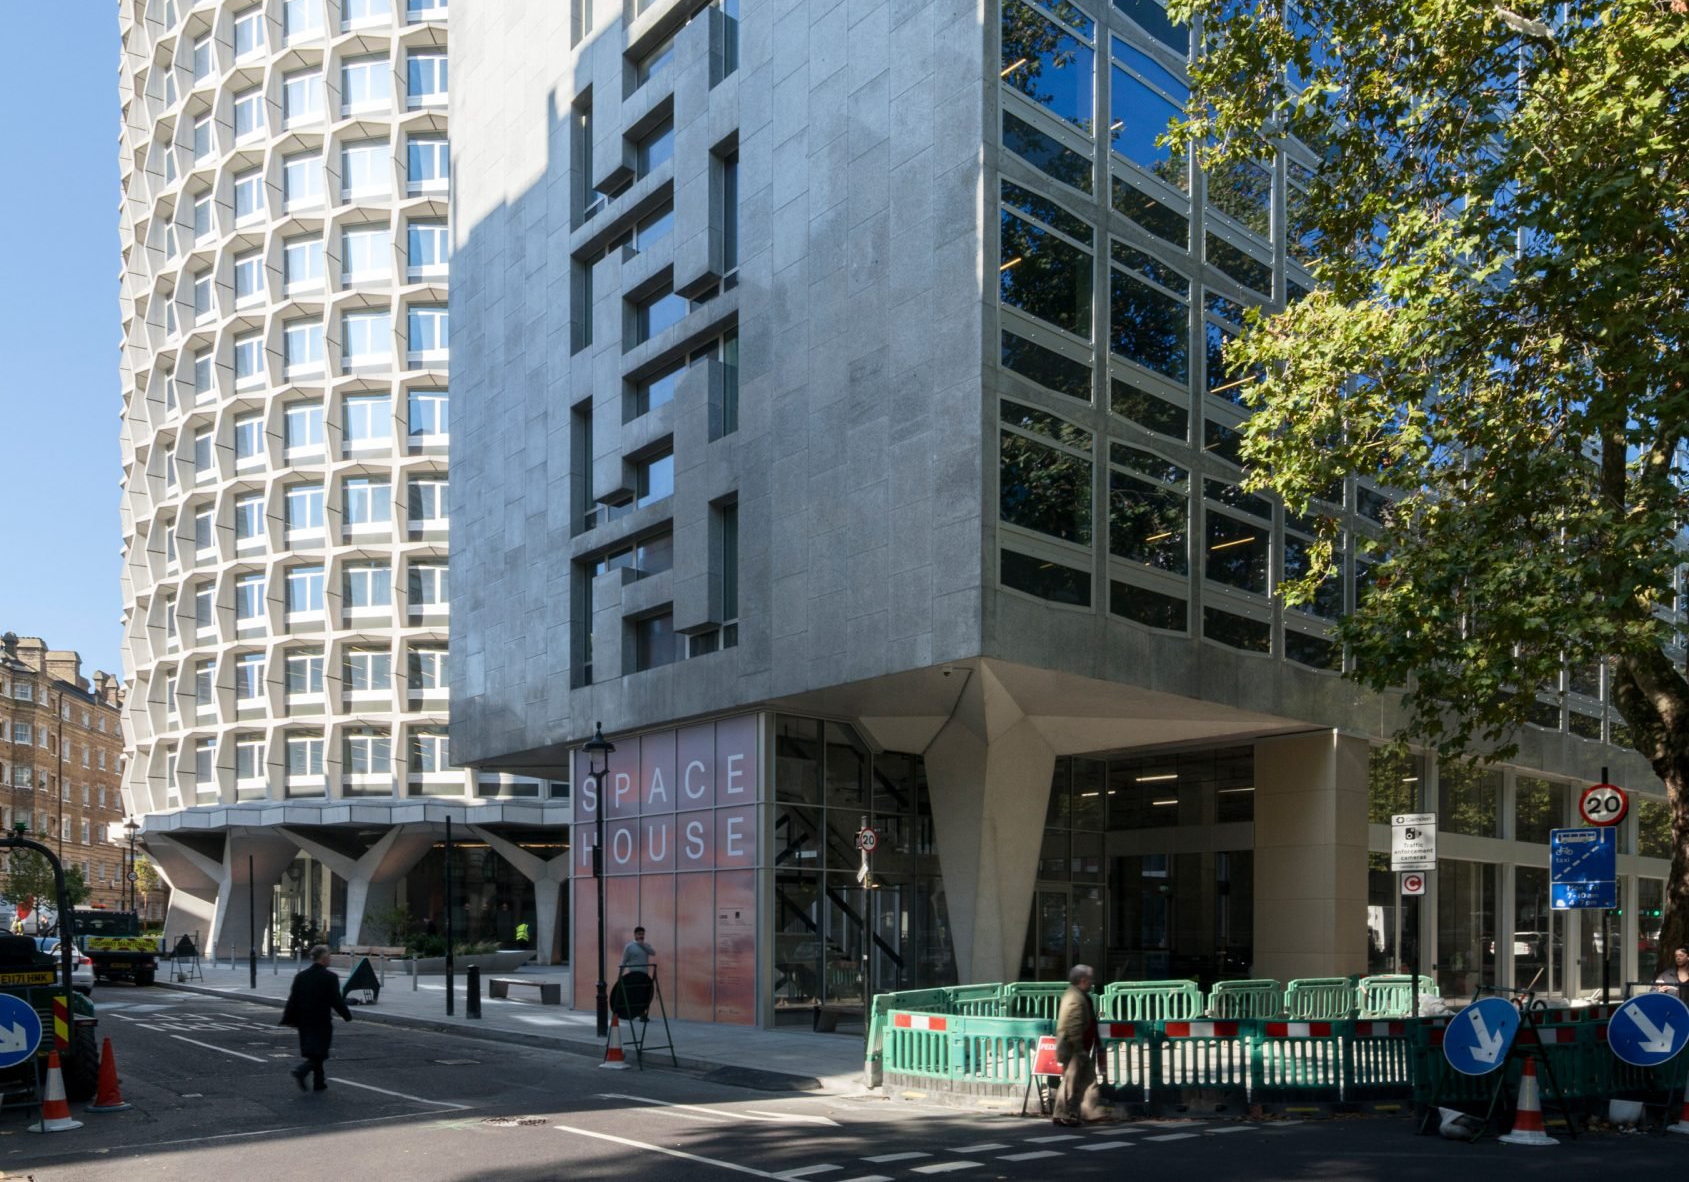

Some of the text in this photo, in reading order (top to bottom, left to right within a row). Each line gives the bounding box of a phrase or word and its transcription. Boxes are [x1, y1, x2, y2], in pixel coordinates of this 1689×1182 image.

[582, 753, 744, 812] SPACE
[1587, 796, 1620, 814] 20
[582, 816, 744, 867] HOUSE
[863, 835, 874, 845] 20
